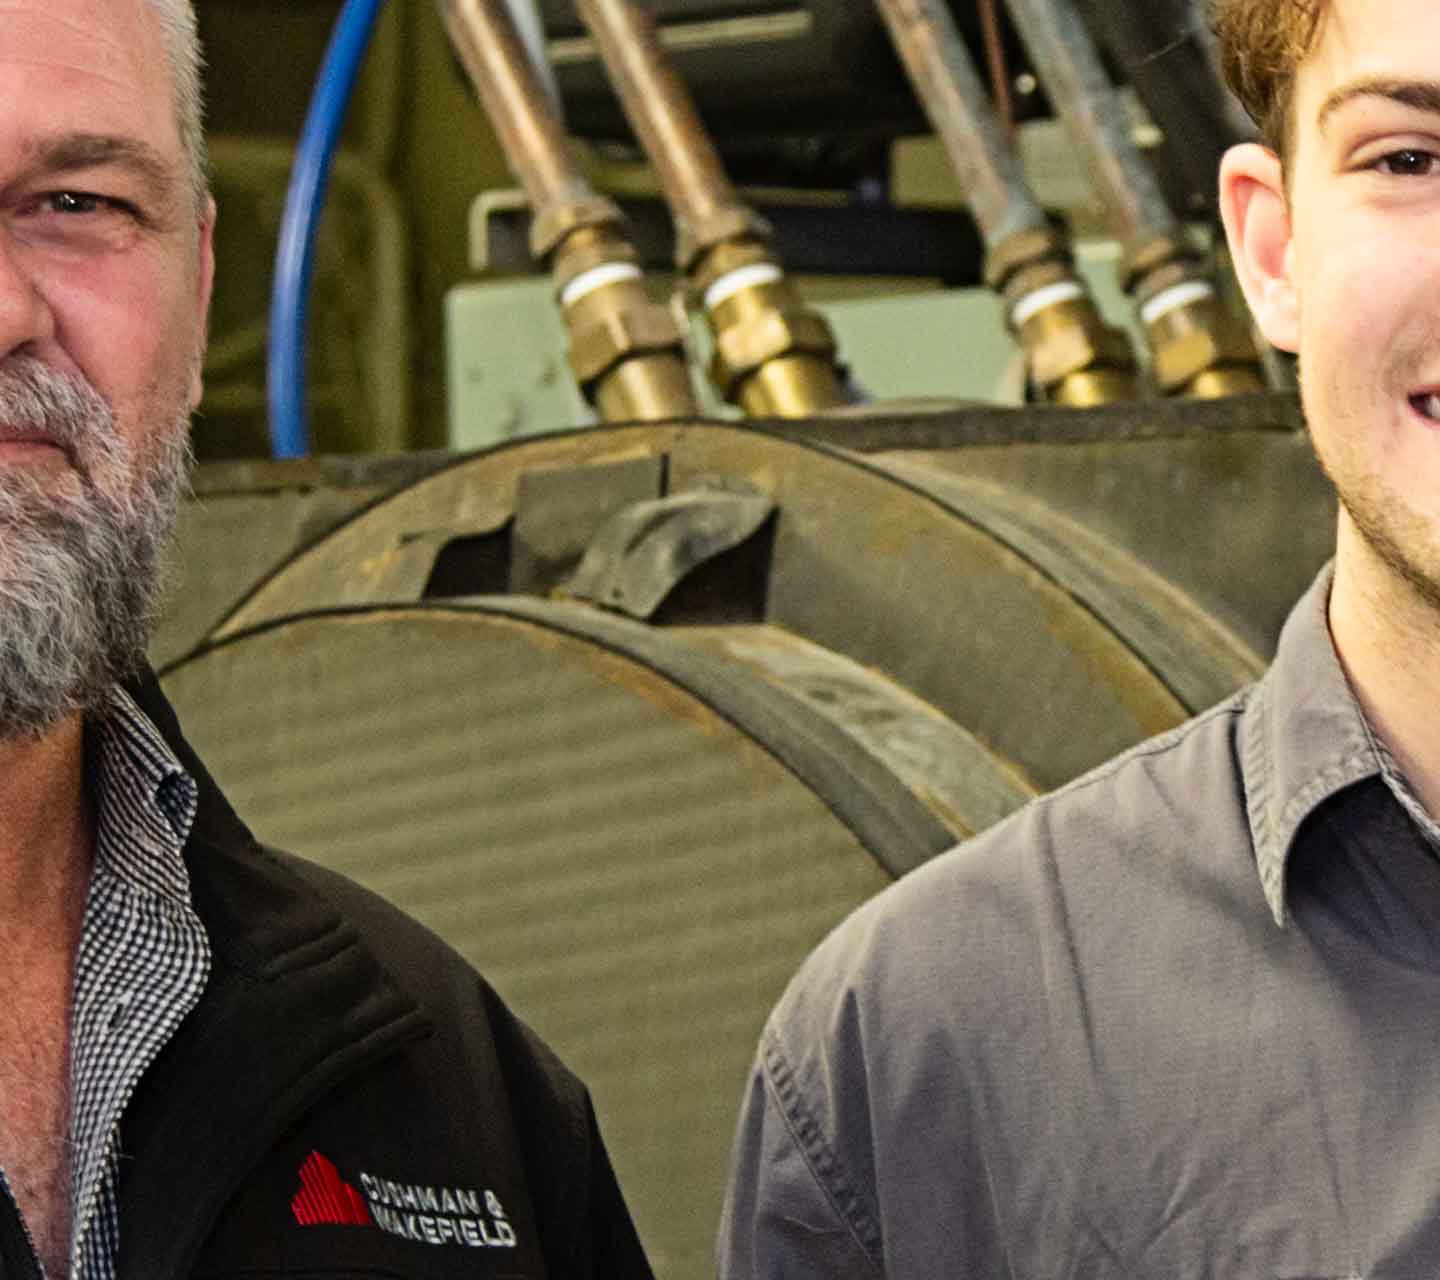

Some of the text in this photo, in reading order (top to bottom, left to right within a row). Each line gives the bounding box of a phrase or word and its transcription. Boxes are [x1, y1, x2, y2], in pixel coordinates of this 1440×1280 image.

[360, 1172, 507, 1219] CUSHMAN &
[369, 1202, 517, 1247] WAKEFIELD
